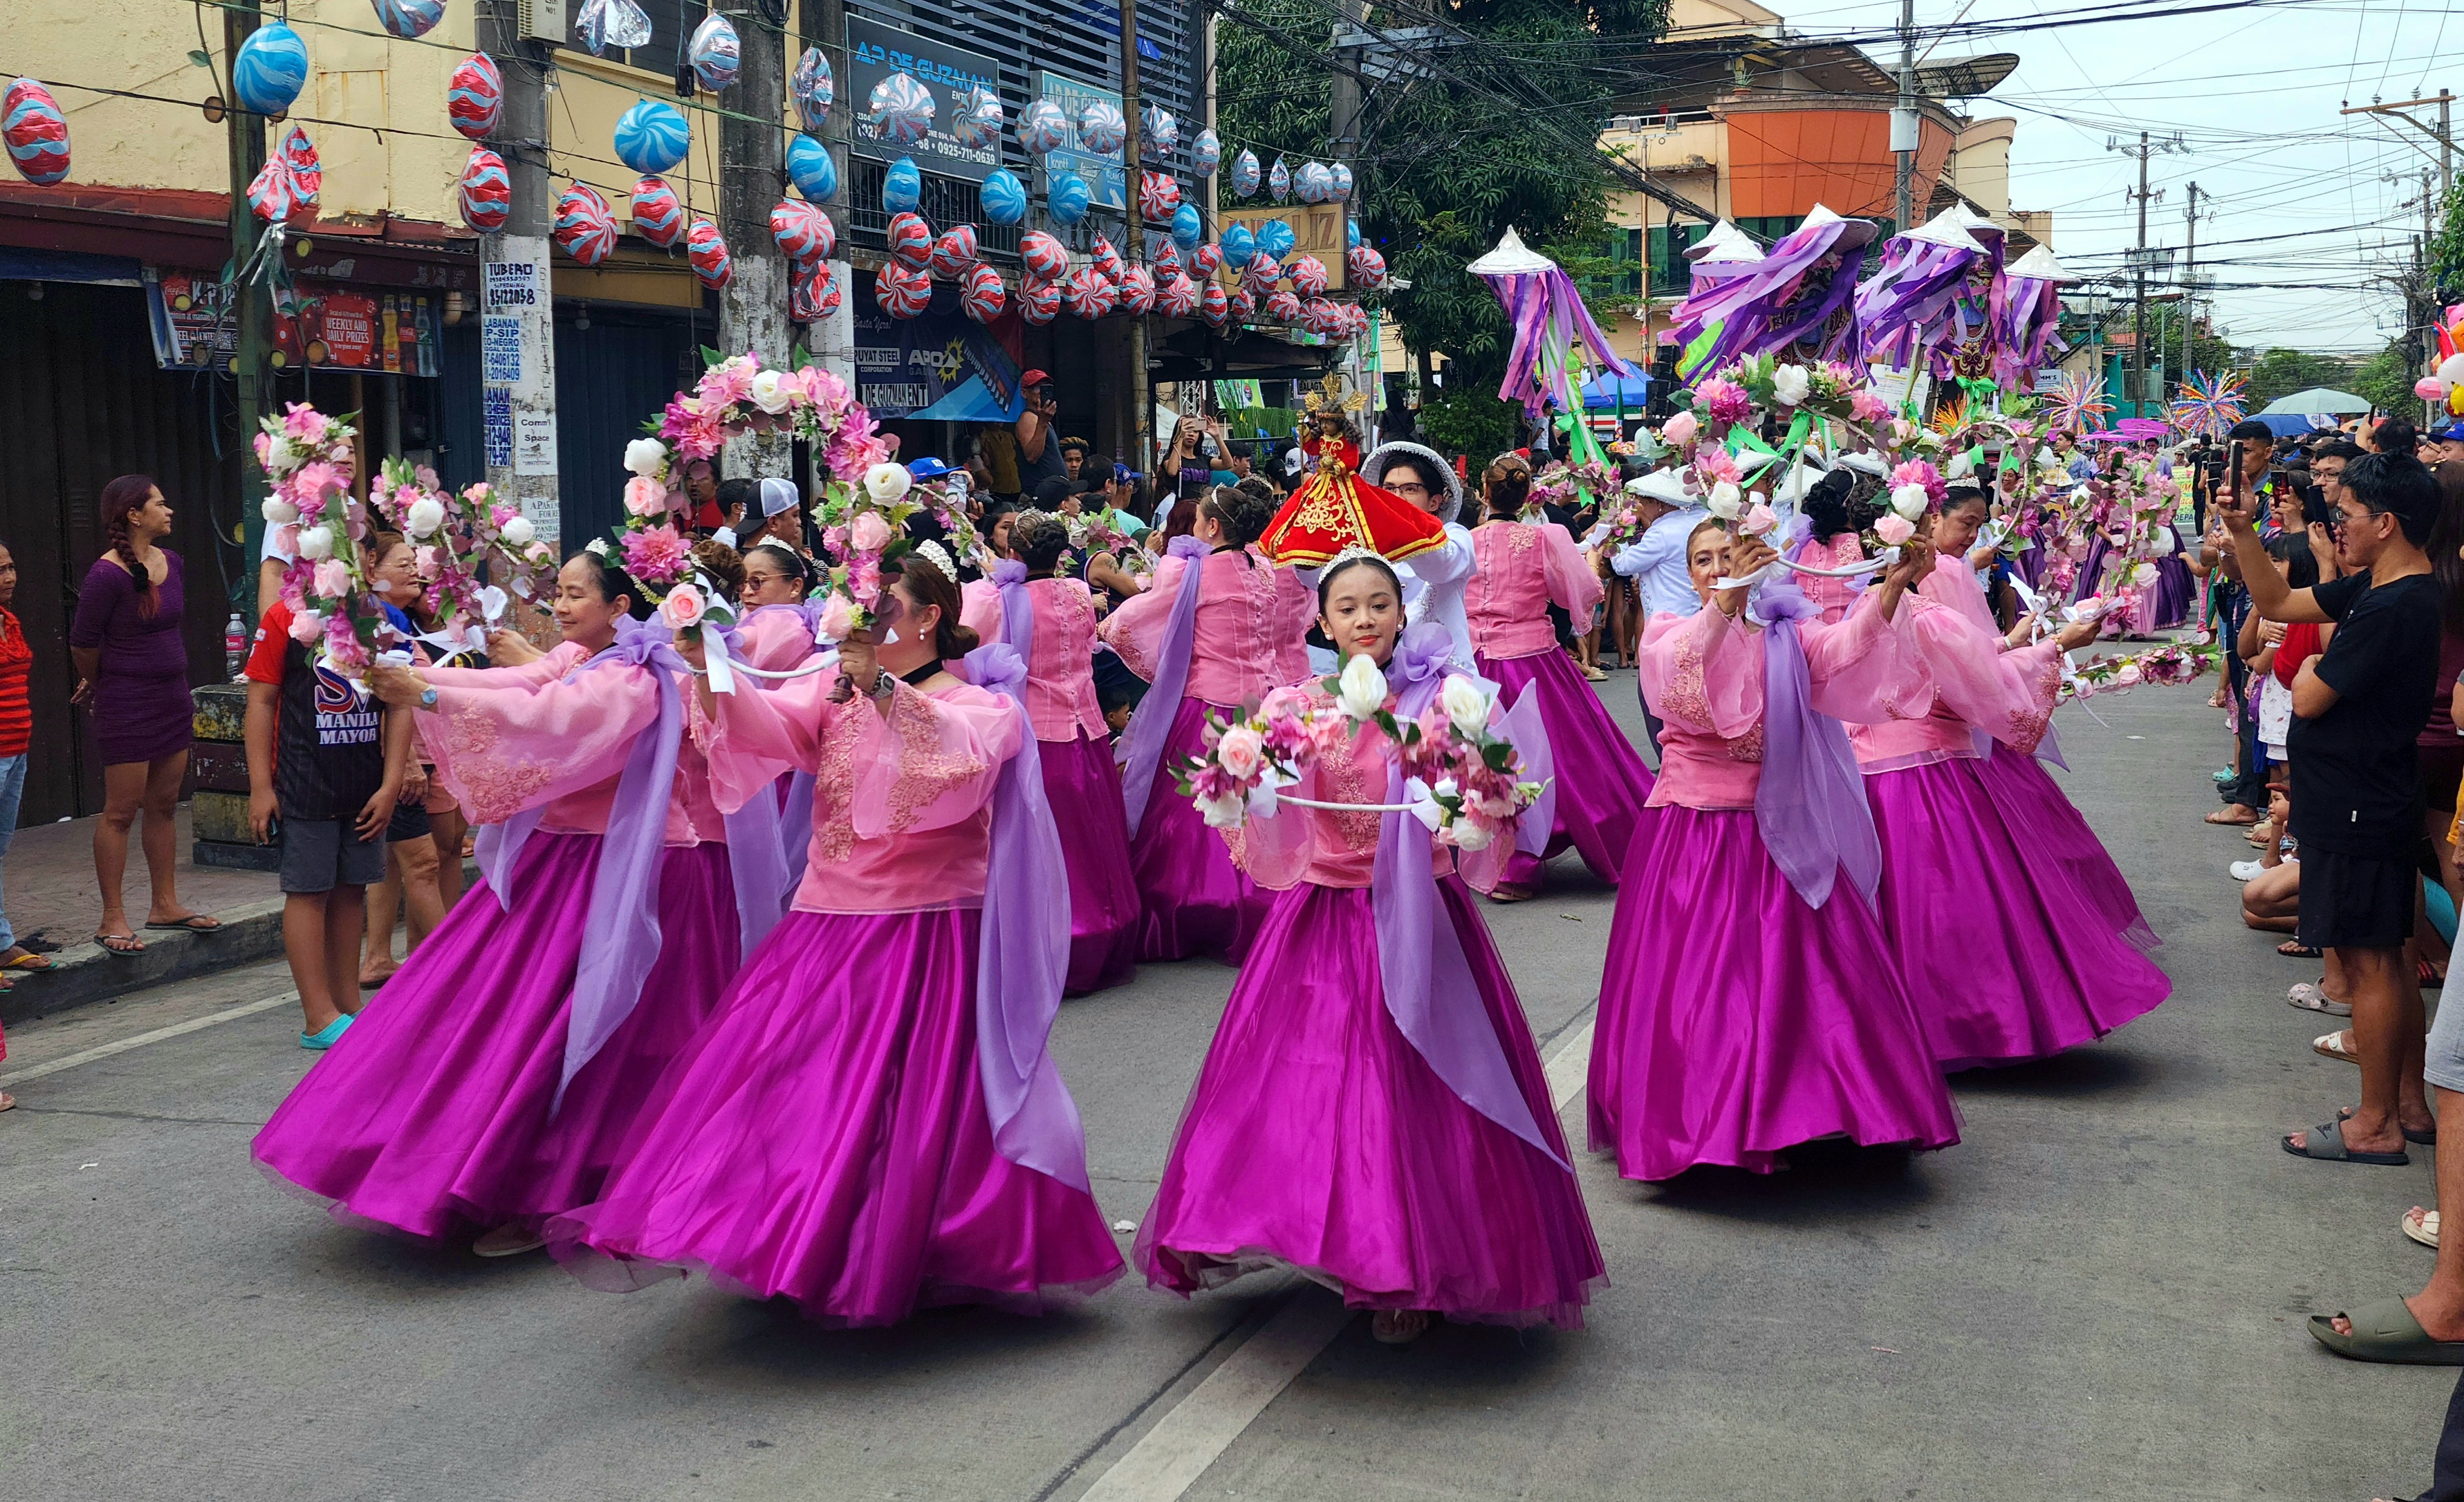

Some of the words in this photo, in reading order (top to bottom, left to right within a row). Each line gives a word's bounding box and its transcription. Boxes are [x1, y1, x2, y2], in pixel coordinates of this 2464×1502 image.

[889, 50, 913, 75] DE
[916, 59, 992, 93] GUZMAN
[1048, 82, 1062, 108] AP
[1065, 86, 1079, 116] DE
[857, 112, 871, 121] 2304
[938, 141, 996, 165] 0925-711-0639
[489, 263, 533, 276] TUBERO
[326, 317, 353, 331] WEEKLY
[354, 320, 367, 332] AND
[327, 330, 345, 342] DAILY
[346, 331, 369, 344] PRIZES
[879, 350, 899, 363] STEEL
[907, 349, 944, 368] APO
[878, 384, 905, 406] GUZMAN
[908, 384, 927, 406] ENT
[524, 434, 549, 443] Space
[315, 712, 378, 728] MANILA
[319, 728, 377, 745] MAYOR
